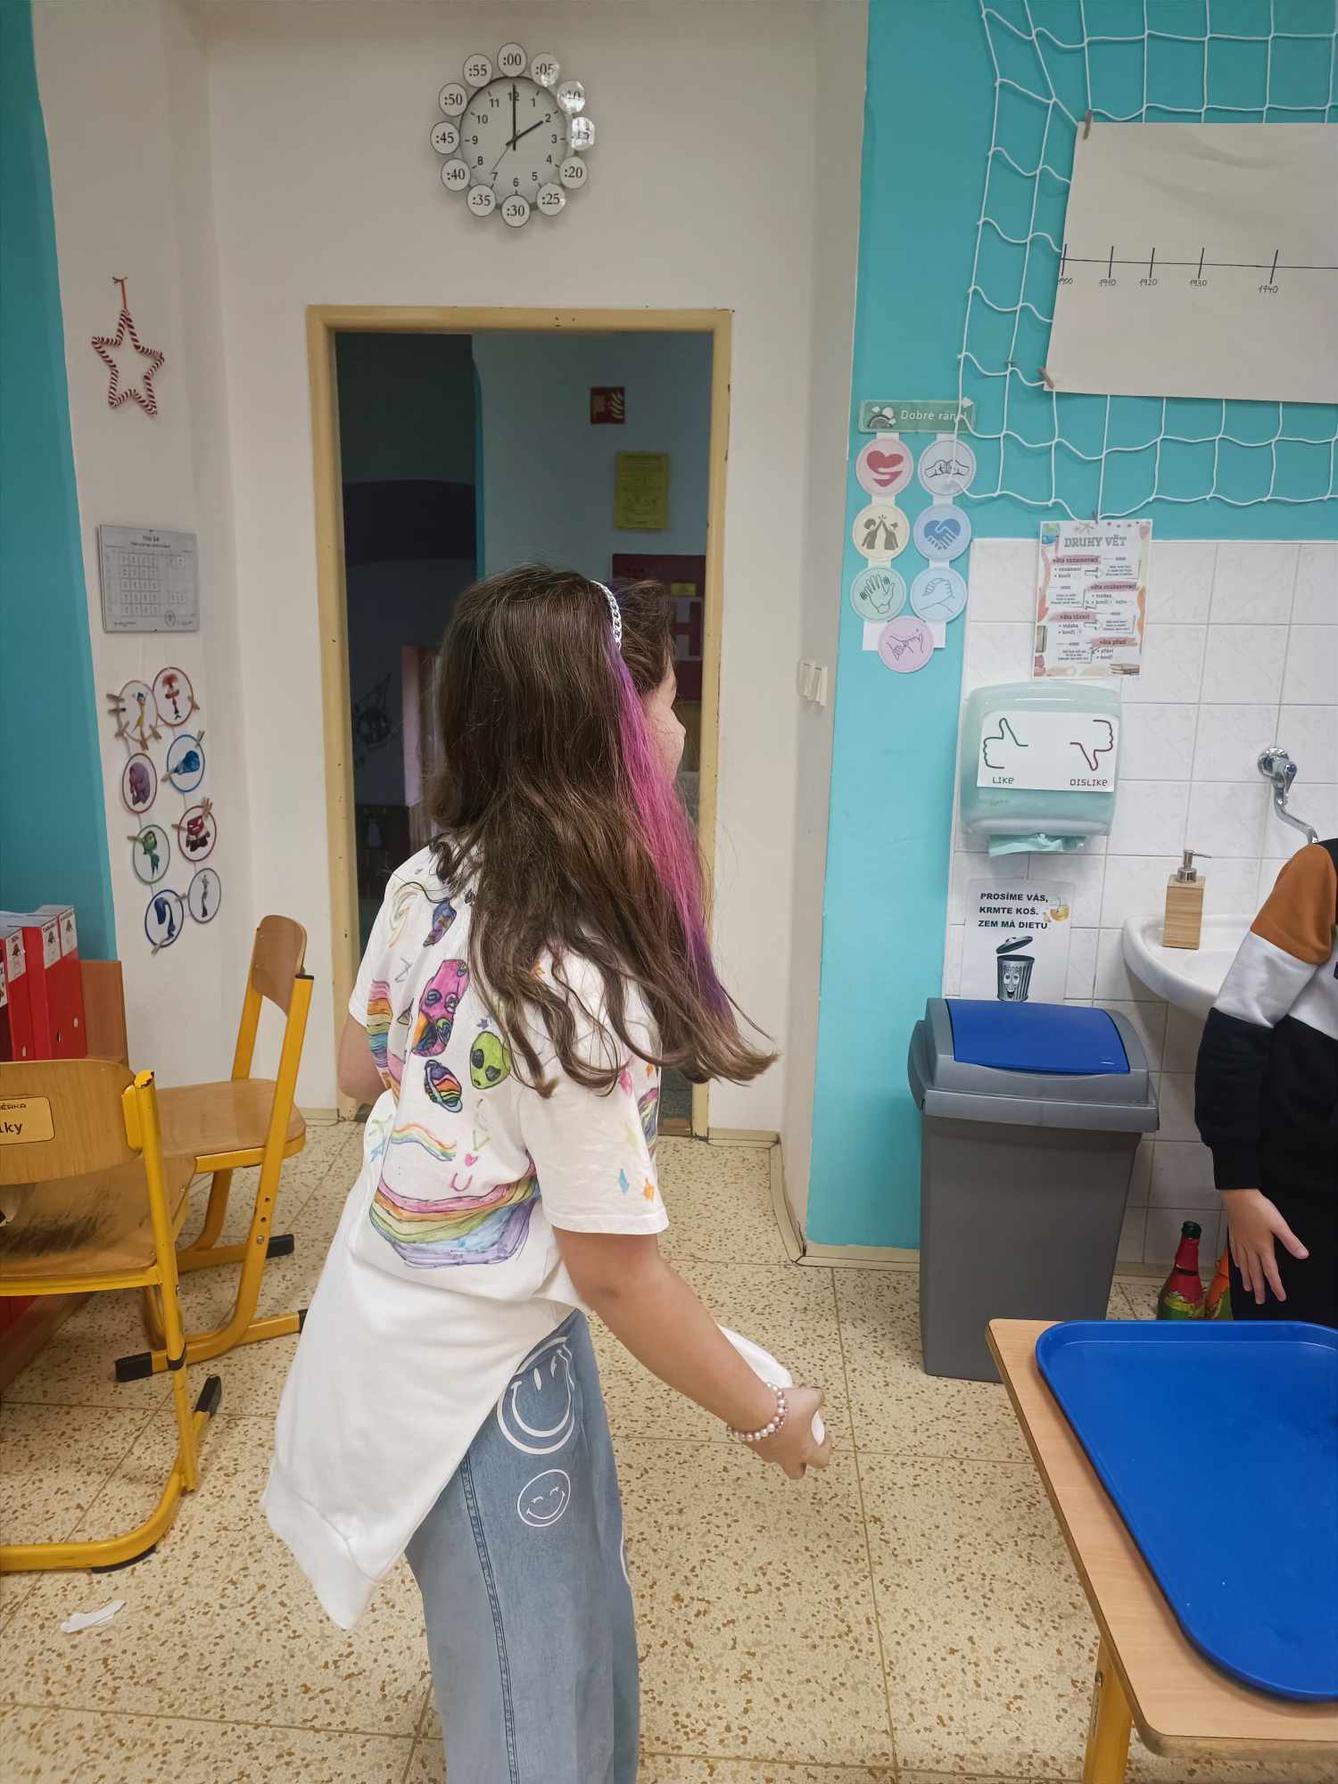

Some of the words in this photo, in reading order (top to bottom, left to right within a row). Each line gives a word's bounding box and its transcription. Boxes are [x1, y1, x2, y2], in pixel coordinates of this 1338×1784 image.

[503, 54, 521, 66] :00
[469, 64, 487, 77] :55
[536, 64, 555, 76] :05
[444, 94, 462, 106] :50
[508, 92, 520, 102] 12
[490, 98, 499, 108] 11
[531, 98, 536, 107] 1
[477, 114, 488, 124] 10
[545, 113, 551, 123] 2
[436, 132, 454, 144] :45
[472, 135, 478, 144] 9
[552, 135, 557, 144] 3
[478, 156, 483, 165] 8
[546, 154, 552, 164] 4
[447, 168, 465, 180] :40
[492, 172, 498, 181] 7
[532, 172, 537, 181] 5
[564, 166, 582, 178] :20
[513, 178, 519, 187] 6
[472, 194, 491, 206] :35
[542, 193, 560, 205] :25
[507, 205, 525, 217] :30
[1139, 278, 1158, 287] 1920
[1064, 537, 1102, 548] DRUHY
[1105, 534, 1128, 546] VĚT
[980, 891, 1024, 902] PROSÍME
[979, 906, 1013, 915] KRMTE
[1015, 906, 1039, 916] KOŠ.
[978, 919, 999, 928] ZEM
[1001, 918, 1016, 928] MÁ
[1018, 921, 1048, 930] DIETU
